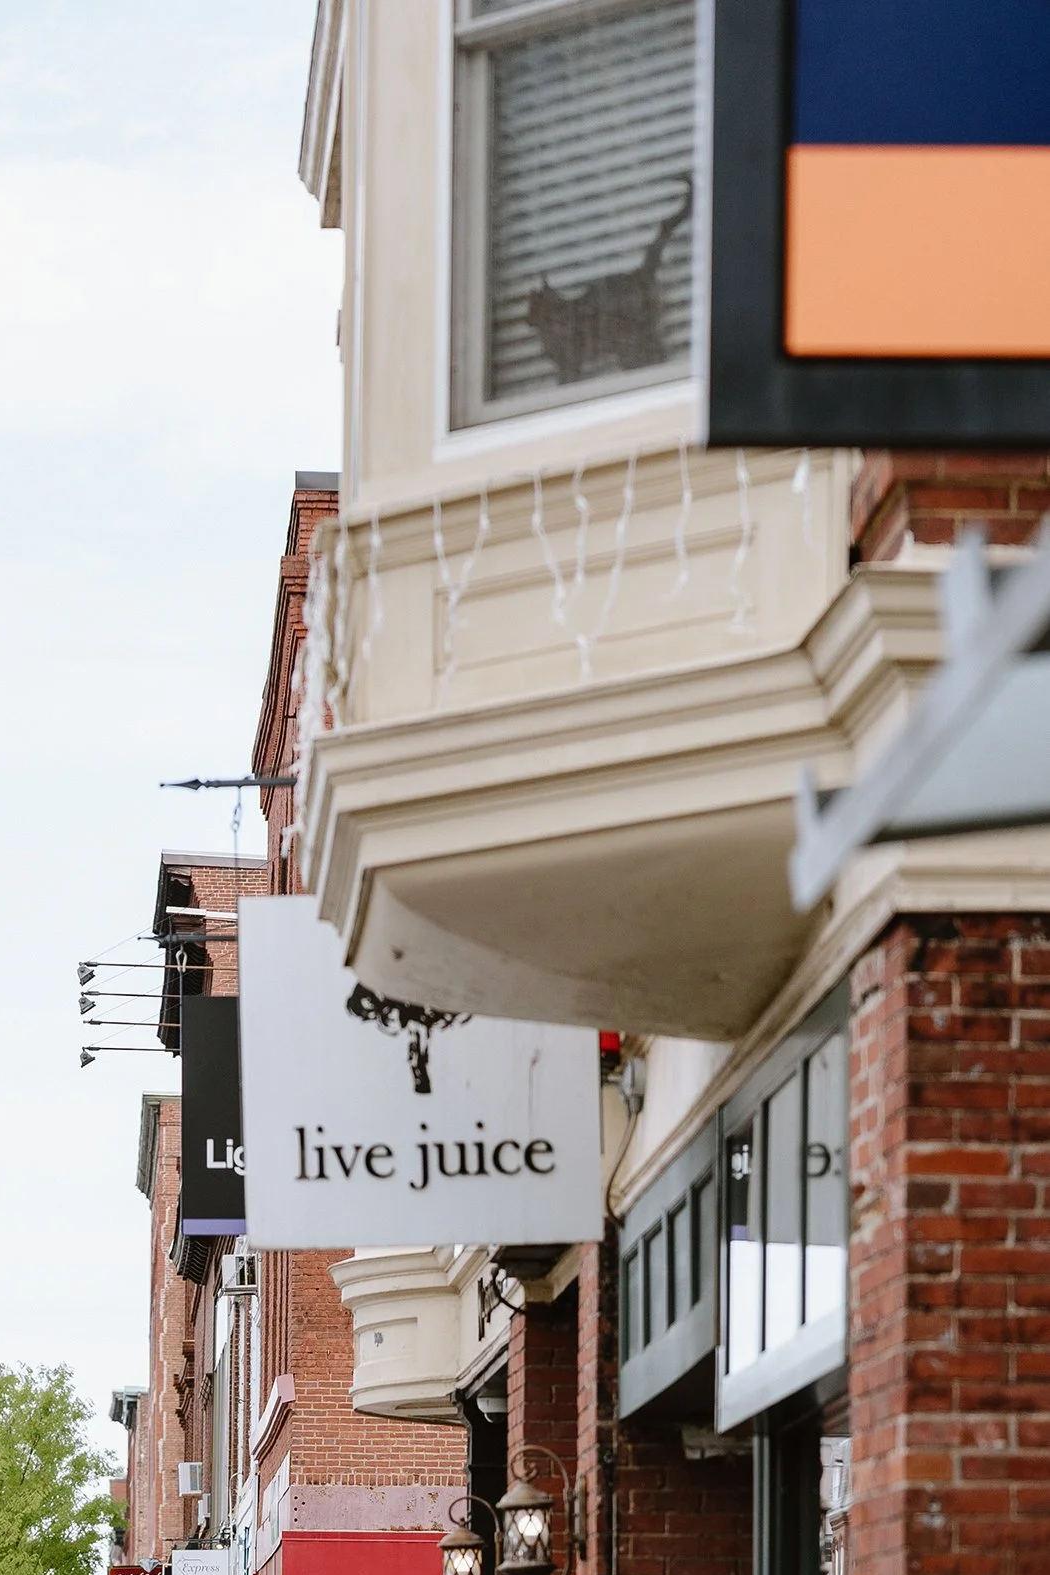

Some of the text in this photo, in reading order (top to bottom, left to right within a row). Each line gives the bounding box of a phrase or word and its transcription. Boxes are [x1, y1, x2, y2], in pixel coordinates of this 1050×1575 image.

[294, 1121, 557, 1191] live juice
[182, 1563, 220, 1574] Express
